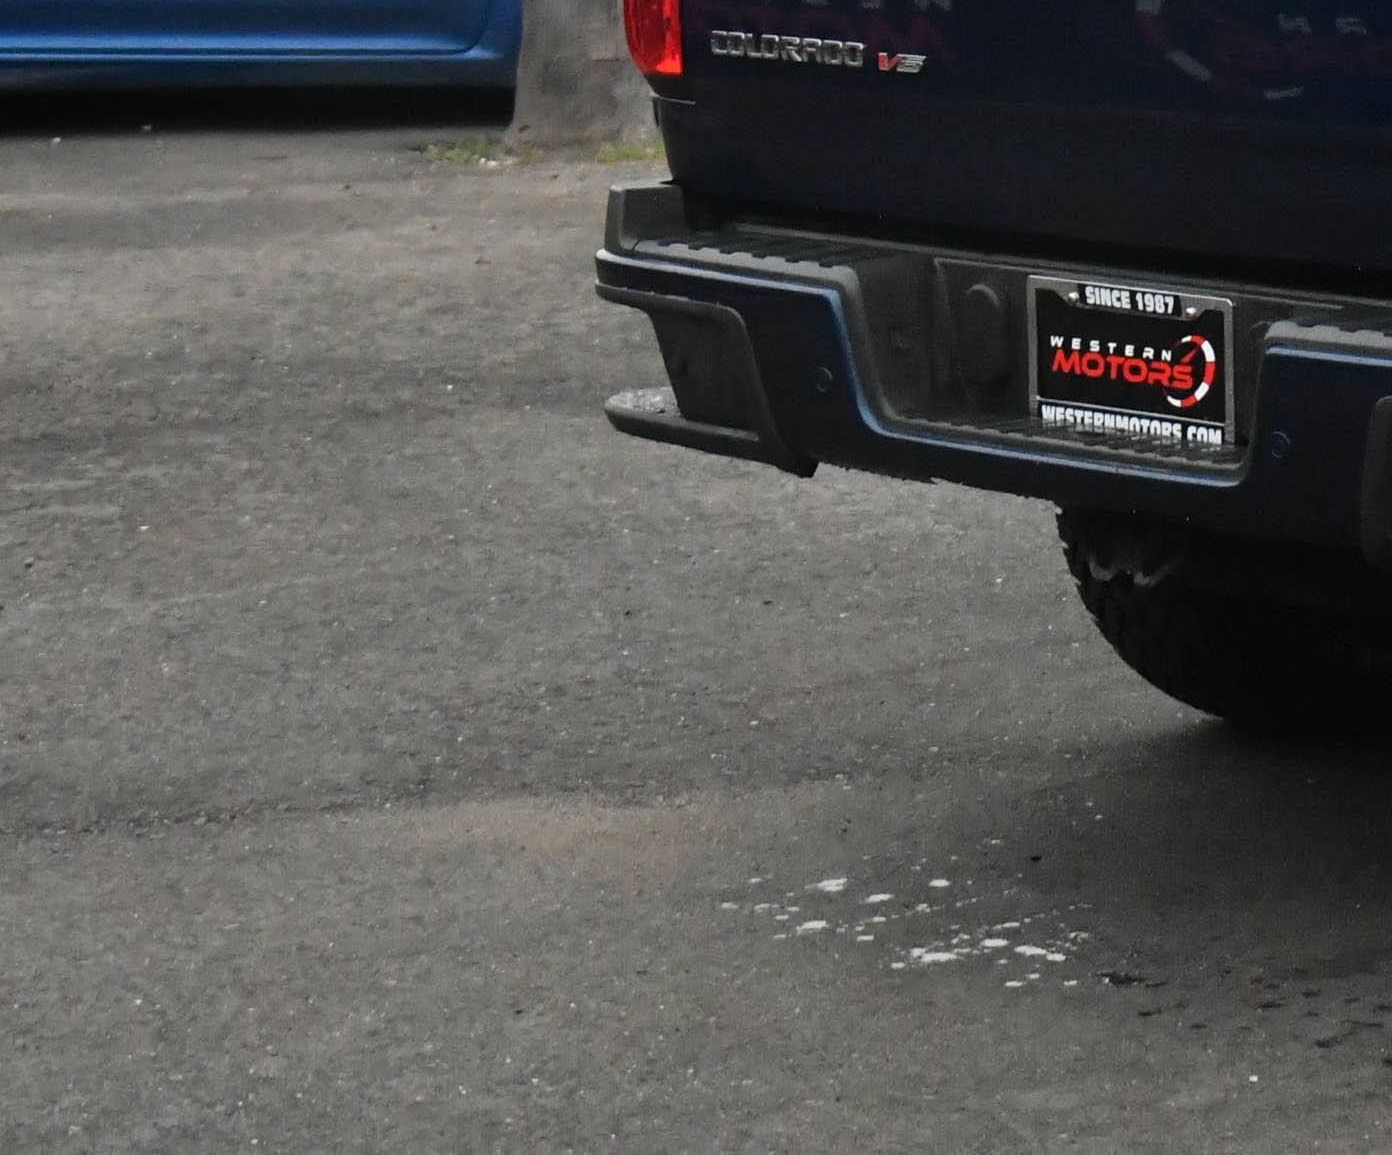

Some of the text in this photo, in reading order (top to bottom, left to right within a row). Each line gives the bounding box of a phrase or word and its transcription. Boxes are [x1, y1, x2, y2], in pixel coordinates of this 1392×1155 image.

[710, 29, 866, 68] COLORADO
[878, 51, 928, 73] V6
[1085, 286, 1175, 315] SINCE 1987
[1050, 335, 1173, 362] WESTERN
[1052, 349, 1195, 390] MOTORS
